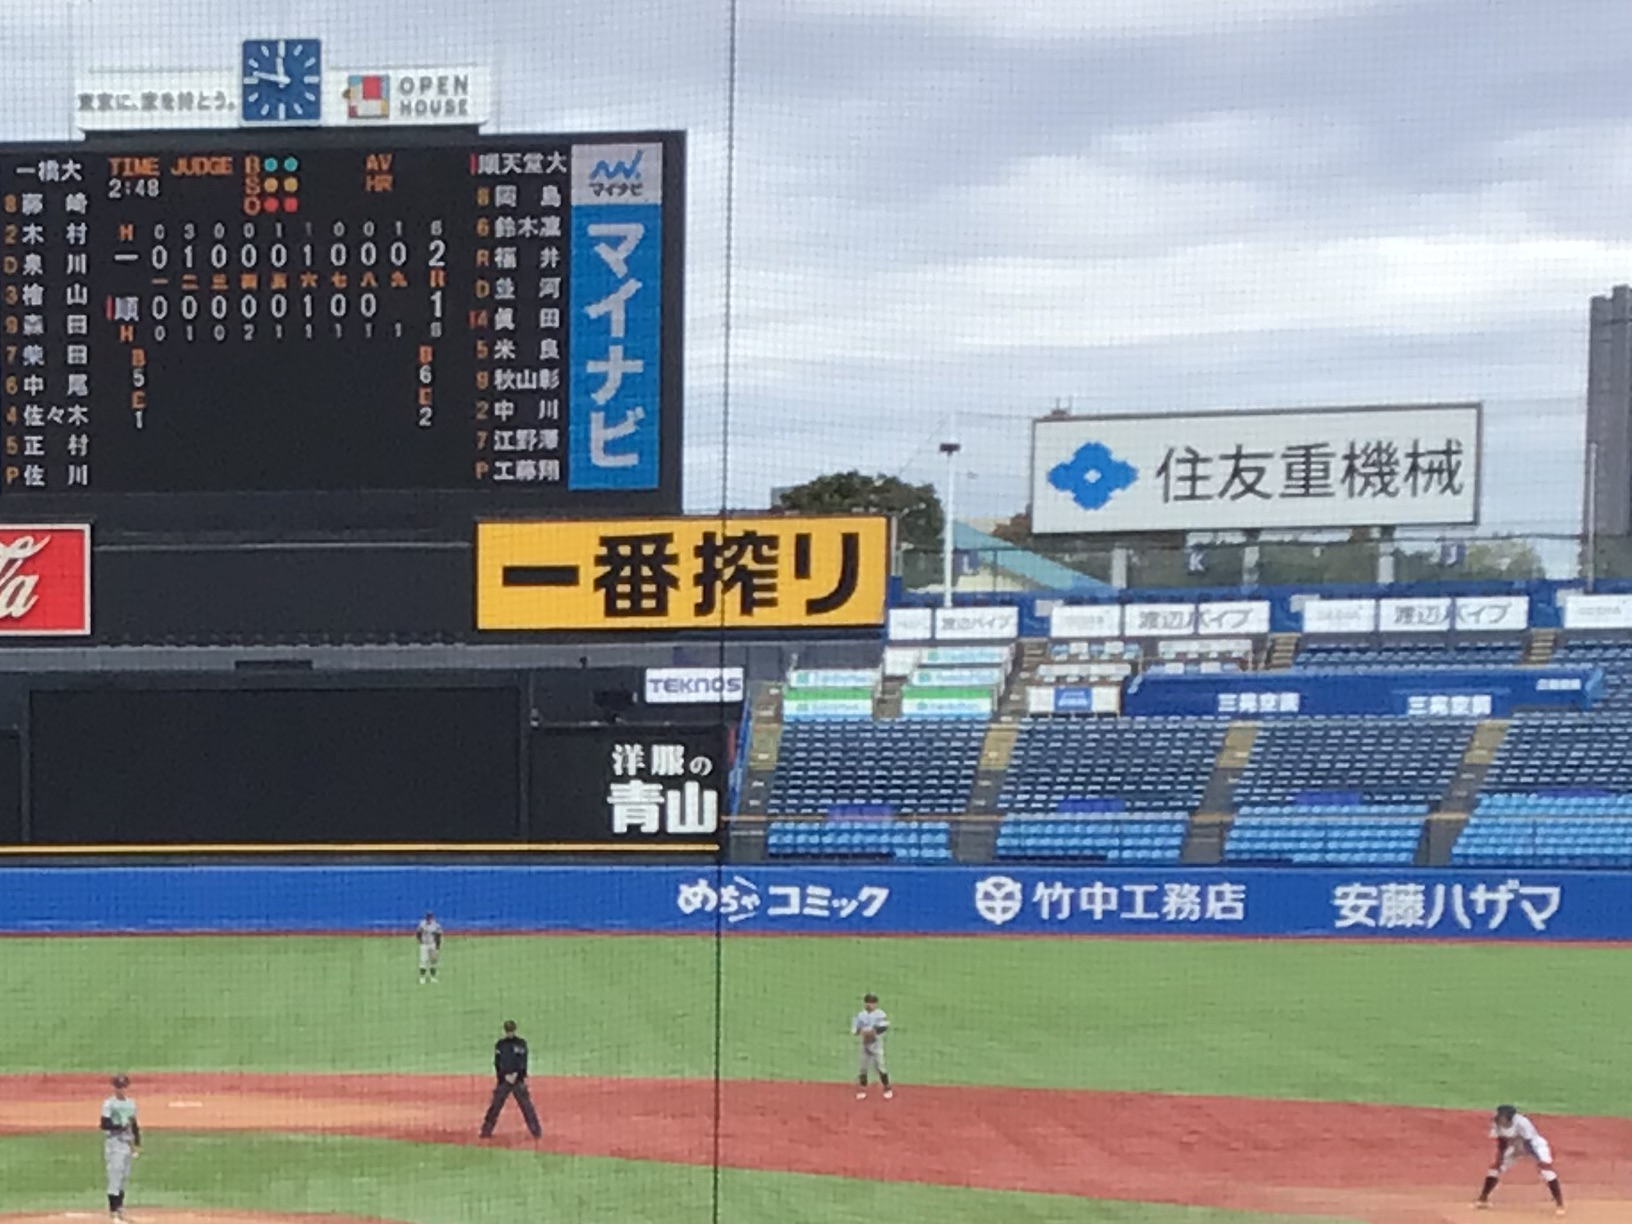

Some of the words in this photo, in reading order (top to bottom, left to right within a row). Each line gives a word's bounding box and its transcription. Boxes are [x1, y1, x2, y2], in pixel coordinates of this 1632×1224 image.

[399, 75, 468, 95] OPEN
[400, 99, 468, 116] HOUSE
[16, 159, 82, 182] 一橋大
[108, 157, 160, 176] TIME
[170, 157, 233, 176] JUDGE
[366, 154, 393, 171] AV
[478, 152, 567, 175] 順天堂大
[108, 178, 160, 198] 2:48
[589, 183, 643, 197] マイナビ
[152, 245, 168, 269] 0
[184, 245, 193, 268] 1
[211, 243, 227, 268] 0
[241, 243, 257, 268] 0
[271, 243, 287, 267] 0
[303, 243, 311, 266] 1
[330, 243, 347, 266] 0
[361, 242, 377, 266] 0
[390, 242, 407, 266] 0
[428, 240, 445, 267] 2
[152, 295, 168, 320] 0
[181, 295, 197, 320] 0
[211, 295, 227, 319] 0
[241, 294, 257, 319] 0
[271, 294, 287, 318] 0
[303, 294, 312, 318] 1
[330, 293, 347, 317] 0
[361, 293, 377, 317] 0
[430, 291, 442, 318] 1
[583, 223, 646, 468] マイナビ
[132, 369, 145, 387] 5
[419, 365, 432, 383] 6
[24, 404, 89, 426] 佐々木
[135, 410, 143, 428] 1
[419, 407, 432, 426] 2
[1156, 437, 1466, 504] 住友重機械
[501, 529, 860, 618] 一番搾り
[648, 677, 742, 693] TEKNOS
[611, 743, 713, 776] 洋服の
[606, 779, 718, 834] 青山
[676, 878, 890, 920] めちゃコミック
[1032, 881, 1247, 922] 竹中工務店
[1332, 878, 1561, 931] 安藤ハザマ
